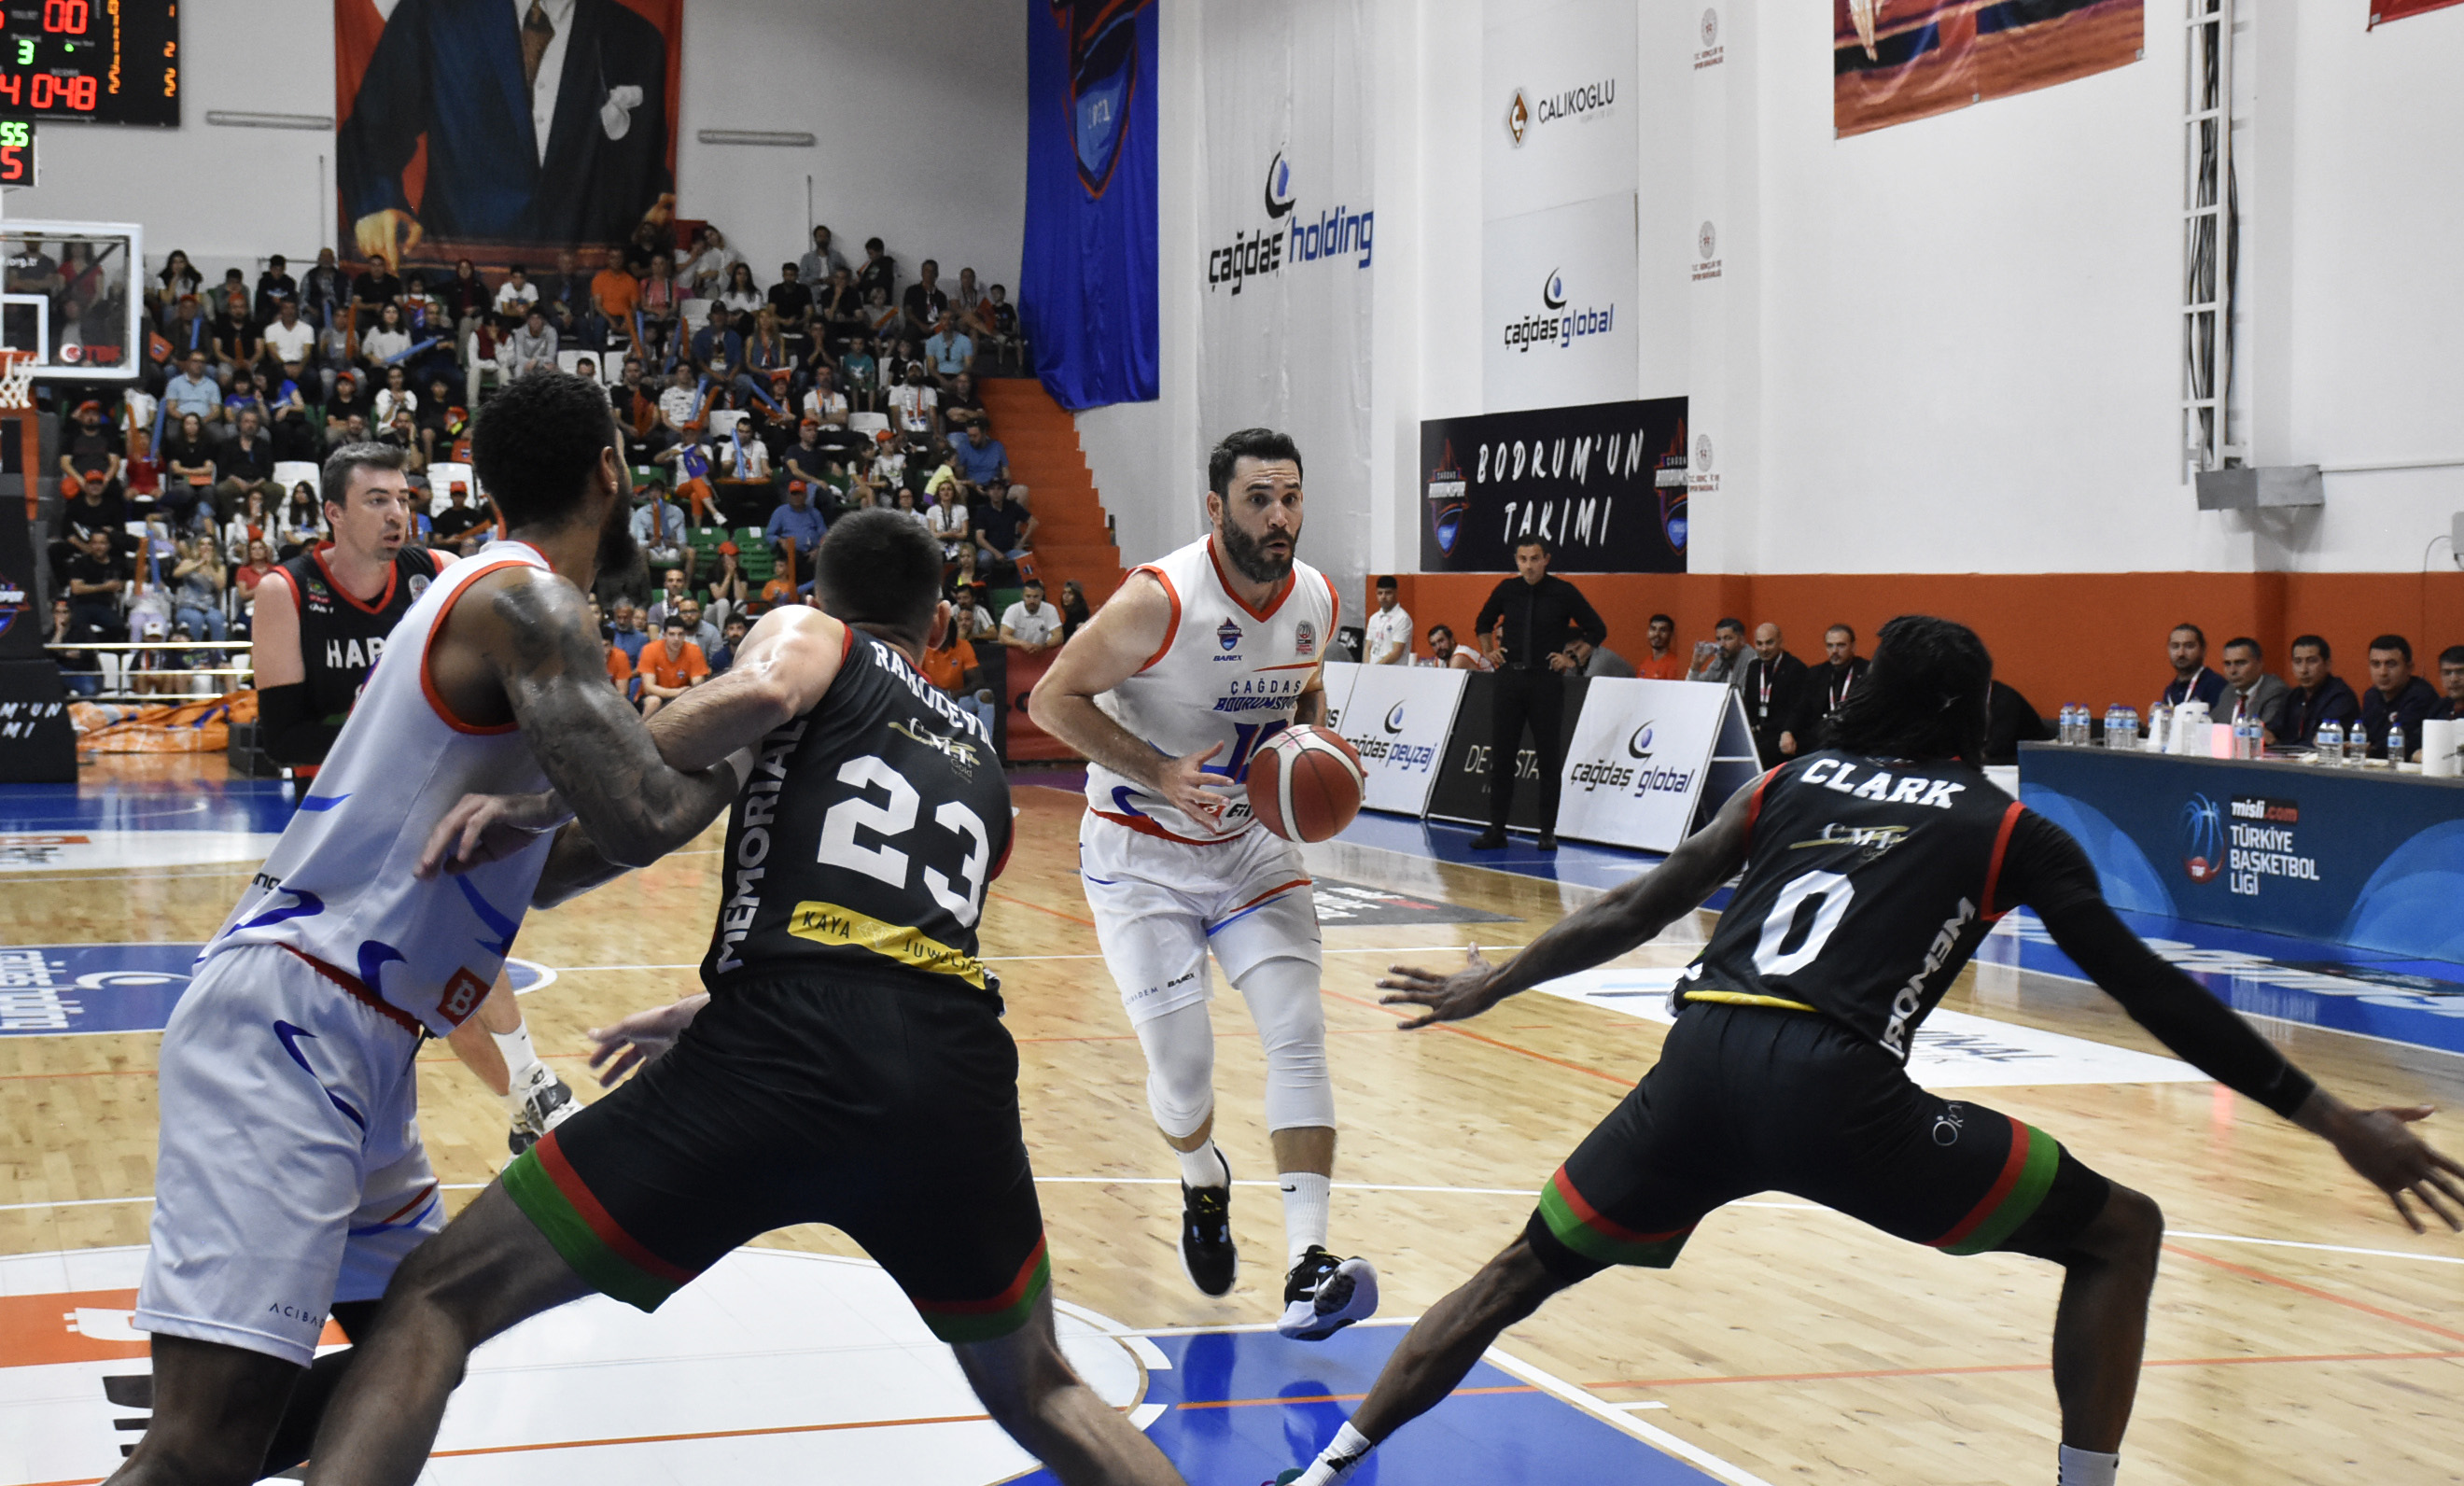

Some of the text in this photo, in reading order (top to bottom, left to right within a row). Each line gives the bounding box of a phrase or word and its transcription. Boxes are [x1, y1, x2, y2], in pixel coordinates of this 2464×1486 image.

[17, 39, 35, 64] 3
[31, 73, 97, 110] 048
[1209, 204, 1374, 296] çağdaş holding
[1505, 302, 1614, 353] çağdaş global
[1477, 428, 1645, 486] BODRUM'UN
[1504, 496, 1613, 547] TAKIMI
[1385, 742, 1437, 773] peyzaj
[1570, 759, 1696, 797] çağdaş global
[1799, 757, 1967, 809] CLARK
[2232, 798, 2299, 823] misli.com
[716, 718, 809, 975] MEMORIAL
[817, 754, 990, 929] 23
[2229, 822, 2293, 853] TÜRKİYE
[2229, 848, 2320, 880] BASKETBOL
[2230, 870, 2260, 896] LİGİ
[802, 910, 851, 940] KAYA
[1751, 869, 1855, 976] 0
